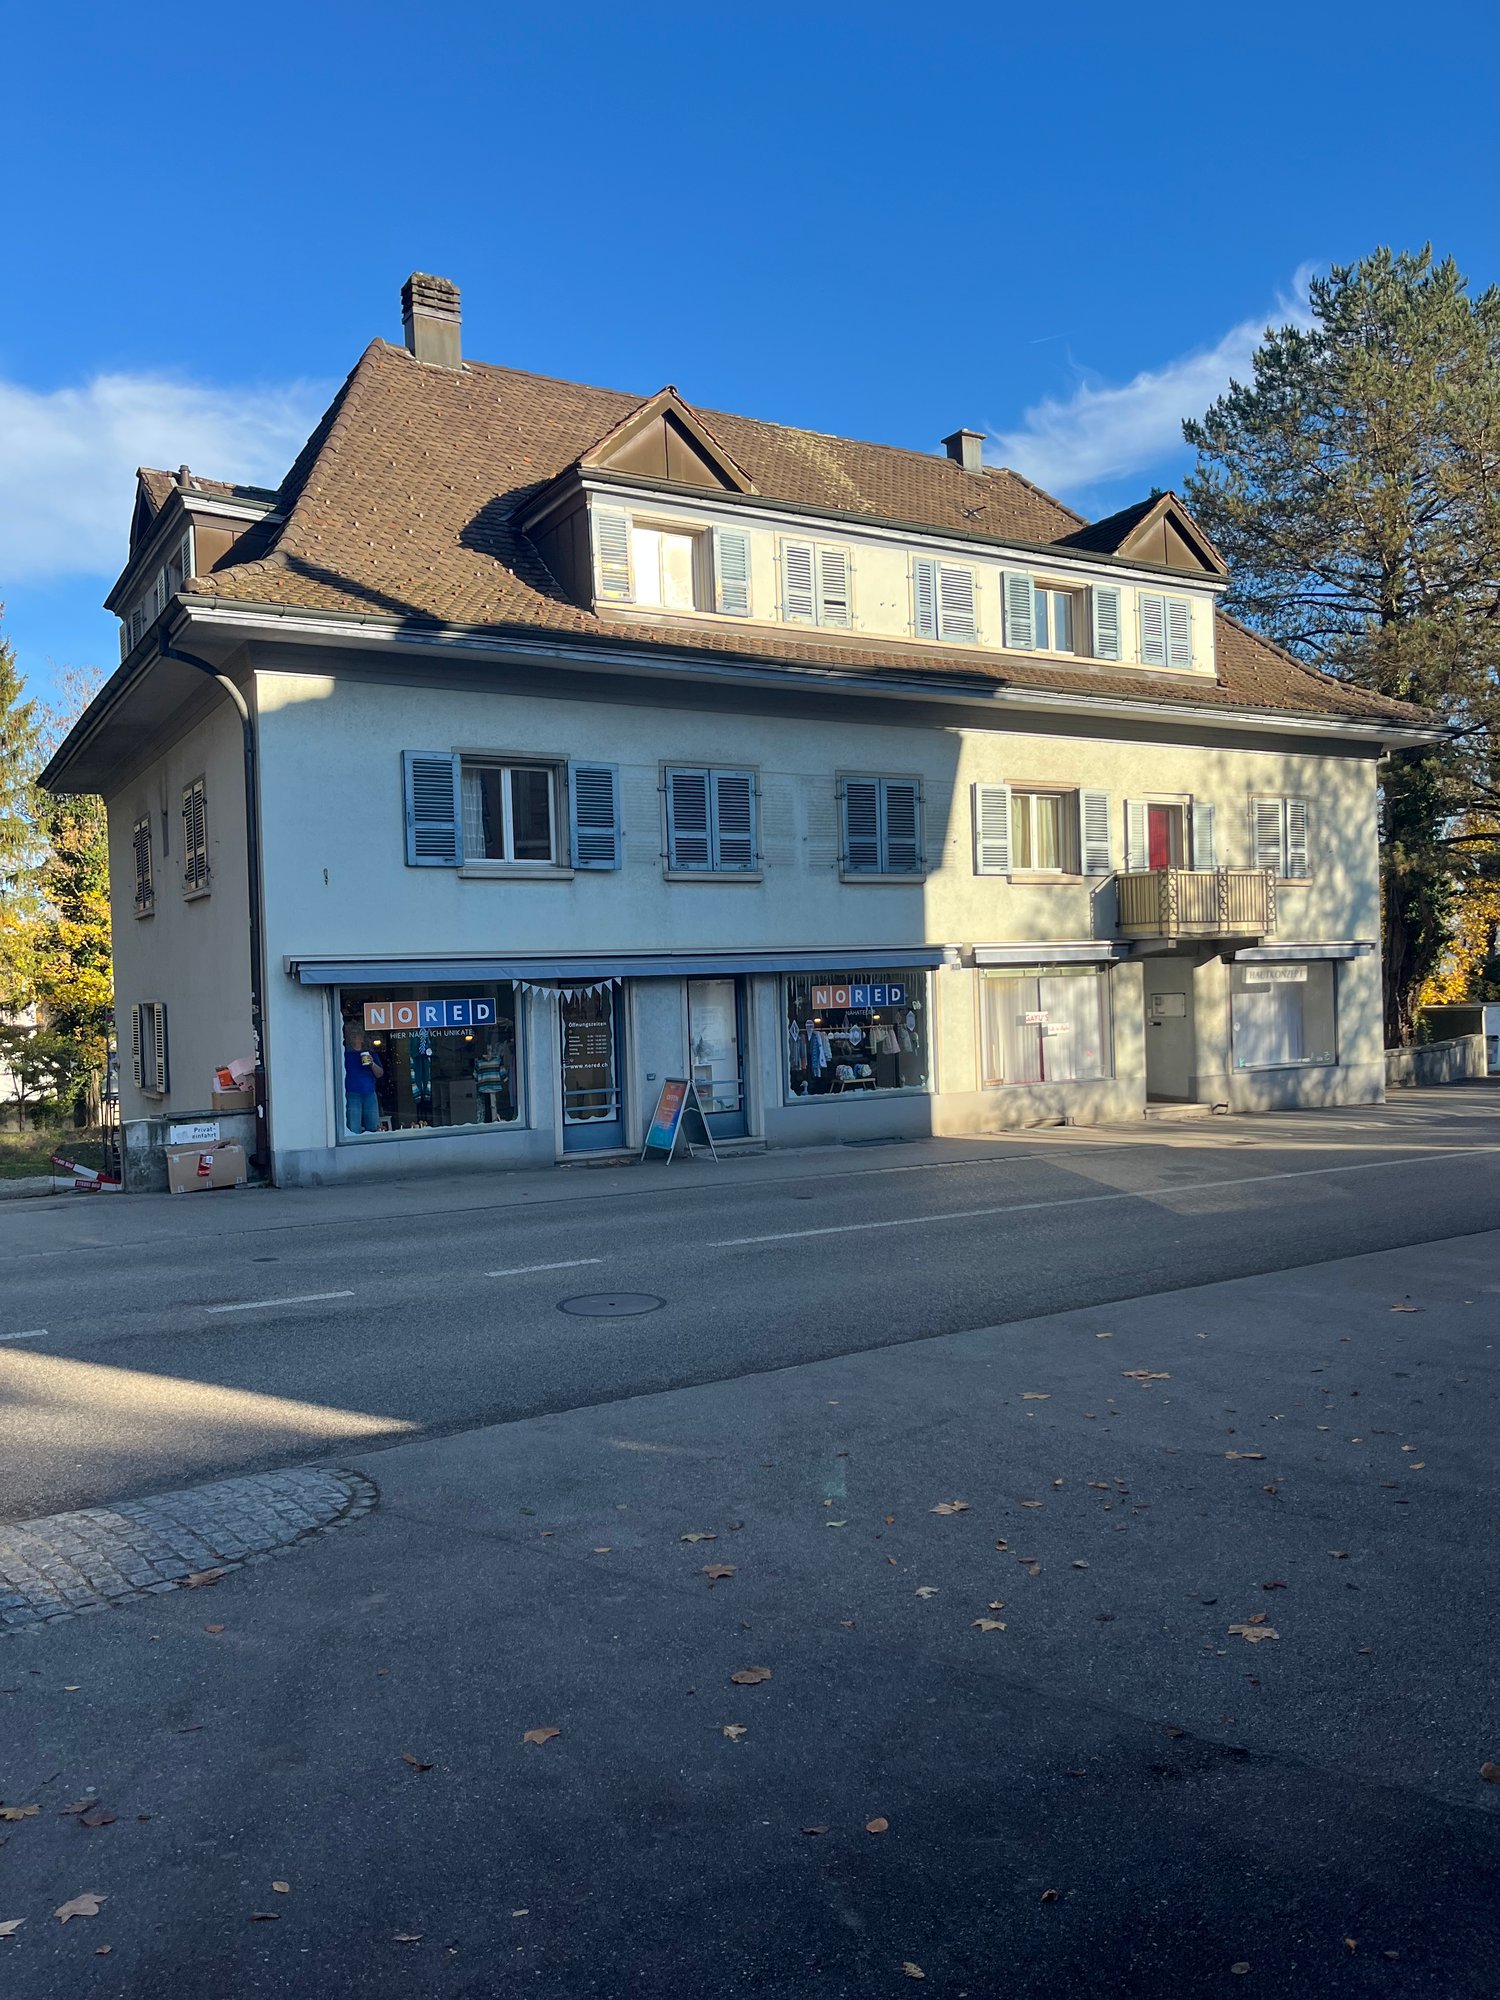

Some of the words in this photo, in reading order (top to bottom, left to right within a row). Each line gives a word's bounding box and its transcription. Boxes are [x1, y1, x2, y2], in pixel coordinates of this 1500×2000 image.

[1249, 969, 1303, 980] HAUTKONZEPT
[816, 988, 901, 1004] NORED
[370, 1004, 490, 1025] NORED
[390, 1031, 406, 1039] HIER
